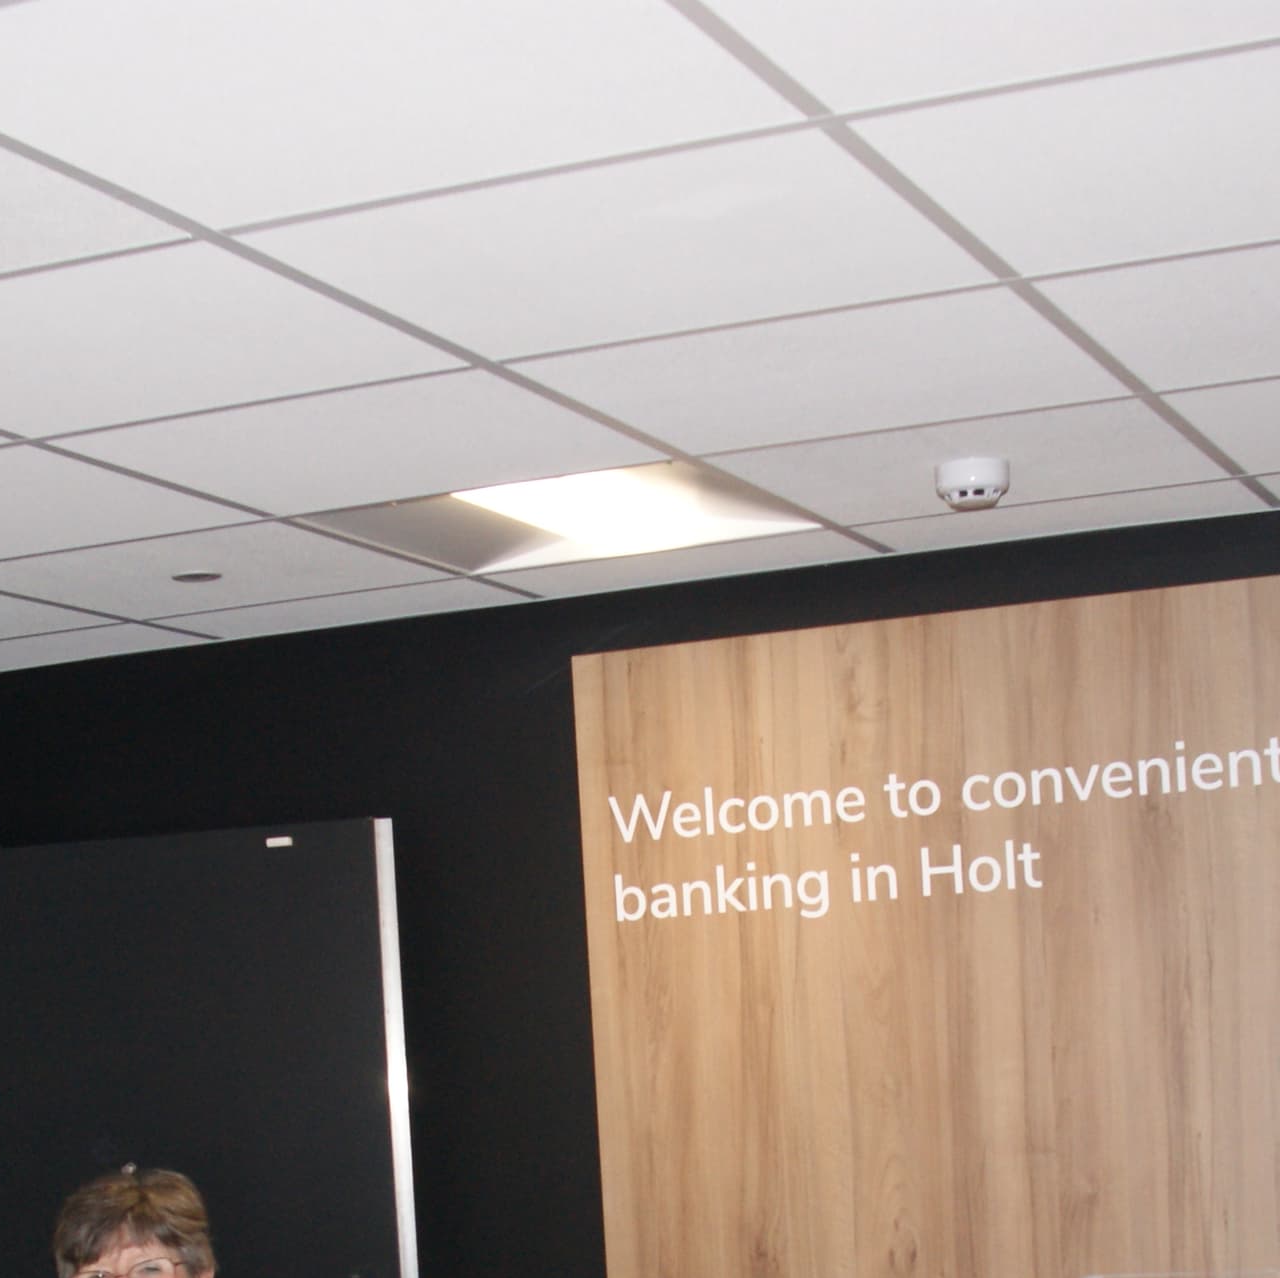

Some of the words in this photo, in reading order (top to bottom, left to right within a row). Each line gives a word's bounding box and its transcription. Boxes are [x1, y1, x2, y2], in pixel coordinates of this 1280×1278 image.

[608, 784, 867, 844] Welcome
[883, 773, 942, 818] to
[613, 861, 830, 923] banking
[850, 853, 898, 903] in
[920, 839, 1043, 897] Holt
